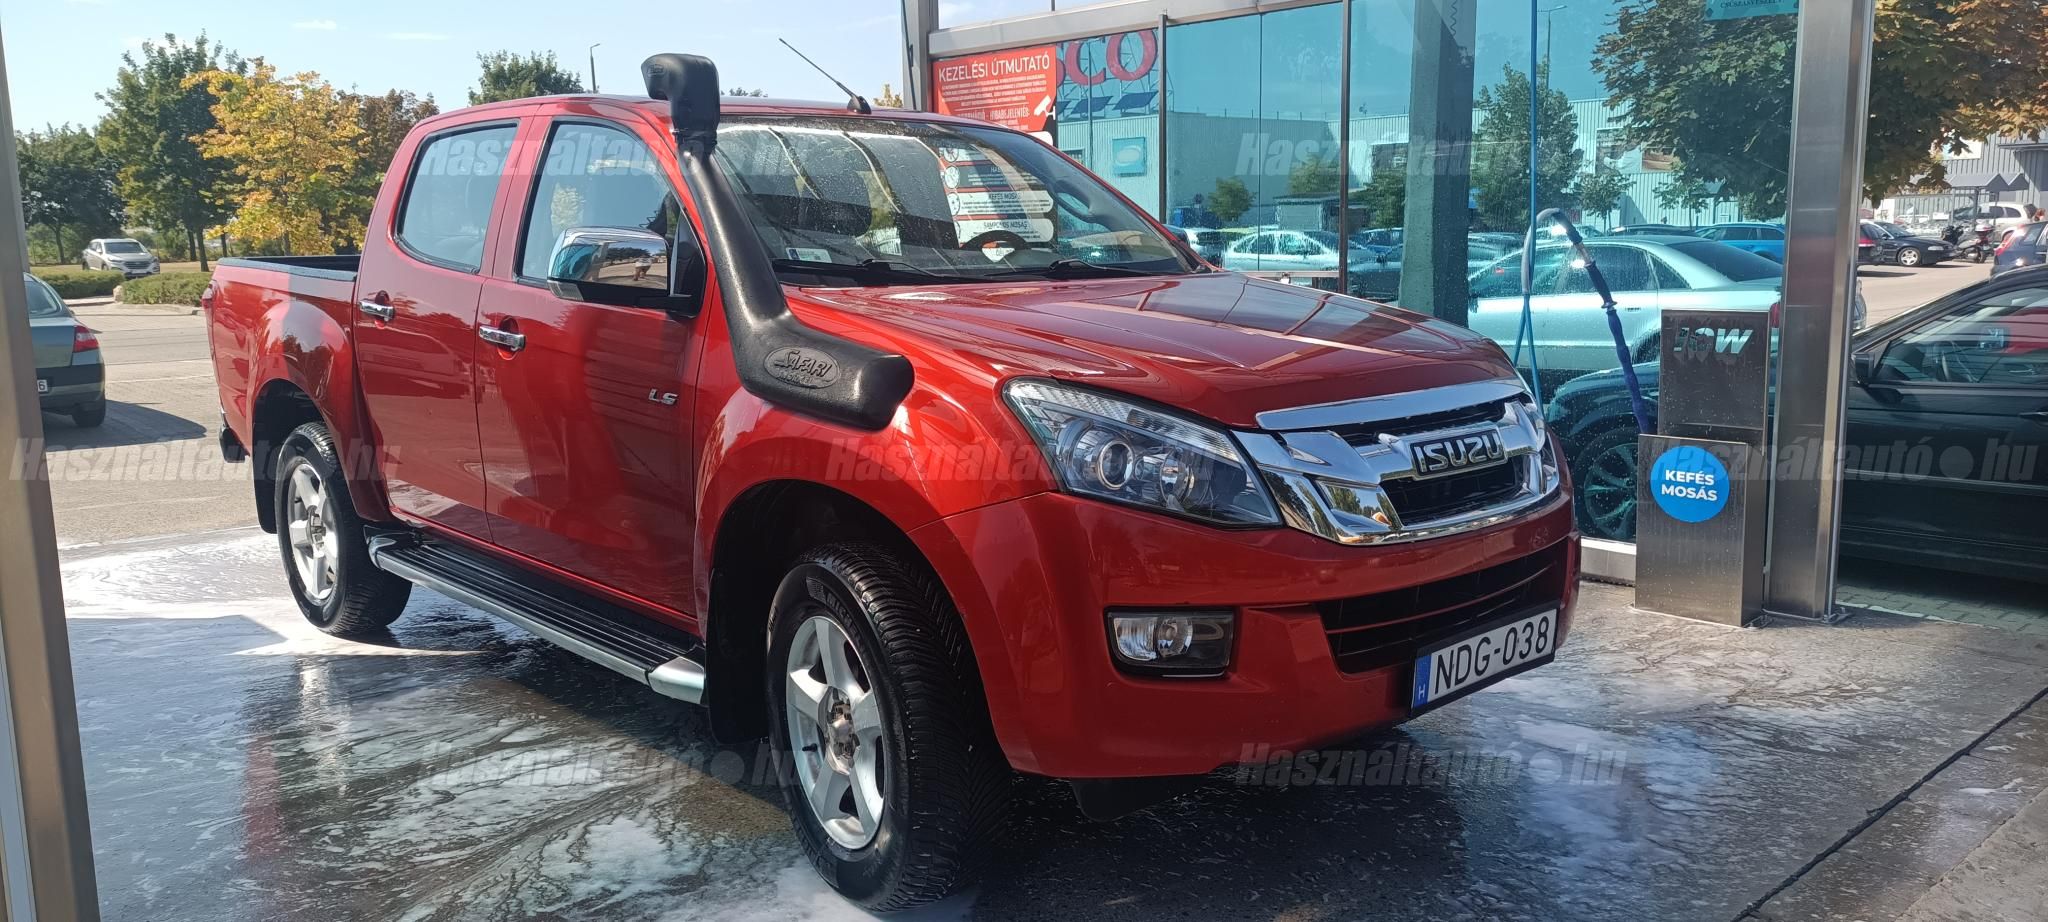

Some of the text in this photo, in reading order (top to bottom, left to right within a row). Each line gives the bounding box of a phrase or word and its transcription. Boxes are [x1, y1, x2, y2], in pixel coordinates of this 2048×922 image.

[938, 60, 989, 83] KEZELÉSI
[991, 51, 1050, 76] ÚTMUTATÓ
[773, 350, 833, 378] SAFARI
[648, 388, 679, 406] LS
[1413, 431, 1501, 473] ISUZU
[1665, 469, 1715, 486] KEFÉS
[1661, 484, 1718, 502] MOSÁS
[1434, 615, 1550, 694] NDG-038
[1417, 682, 1426, 699] H
